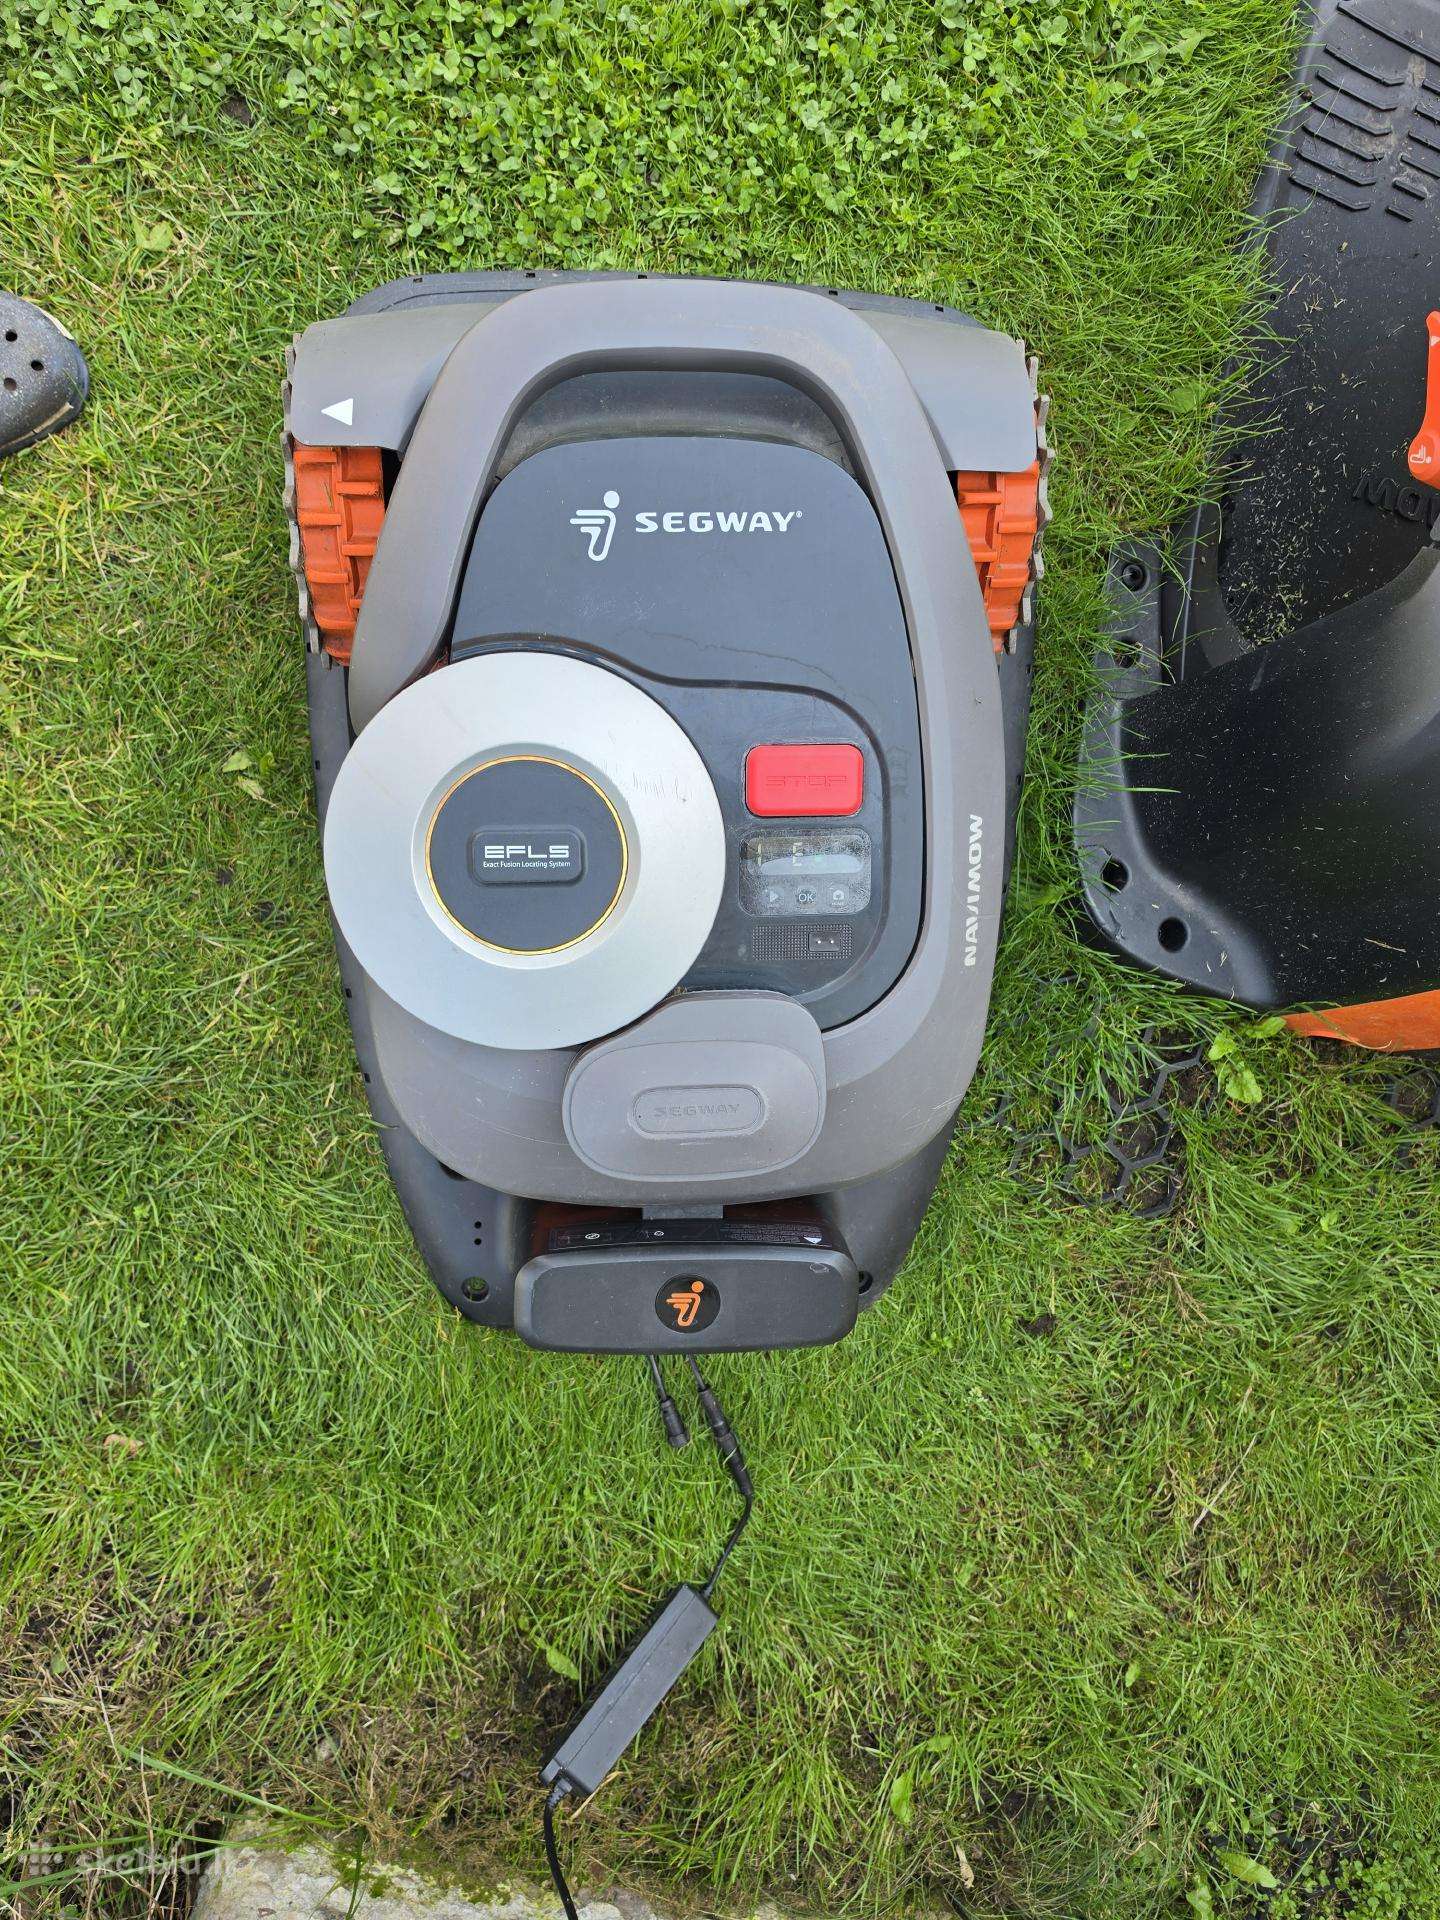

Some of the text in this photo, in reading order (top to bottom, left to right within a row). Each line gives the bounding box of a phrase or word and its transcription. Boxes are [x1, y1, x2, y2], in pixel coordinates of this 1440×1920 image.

[765, 775, 848, 788] STOP
[484, 845, 570, 859] EFLS
[521, 861, 548, 869] Locating
[549, 861, 571, 869] System
[964, 813, 983, 967] NAVIMOW
[798, 892, 815, 903] OK
